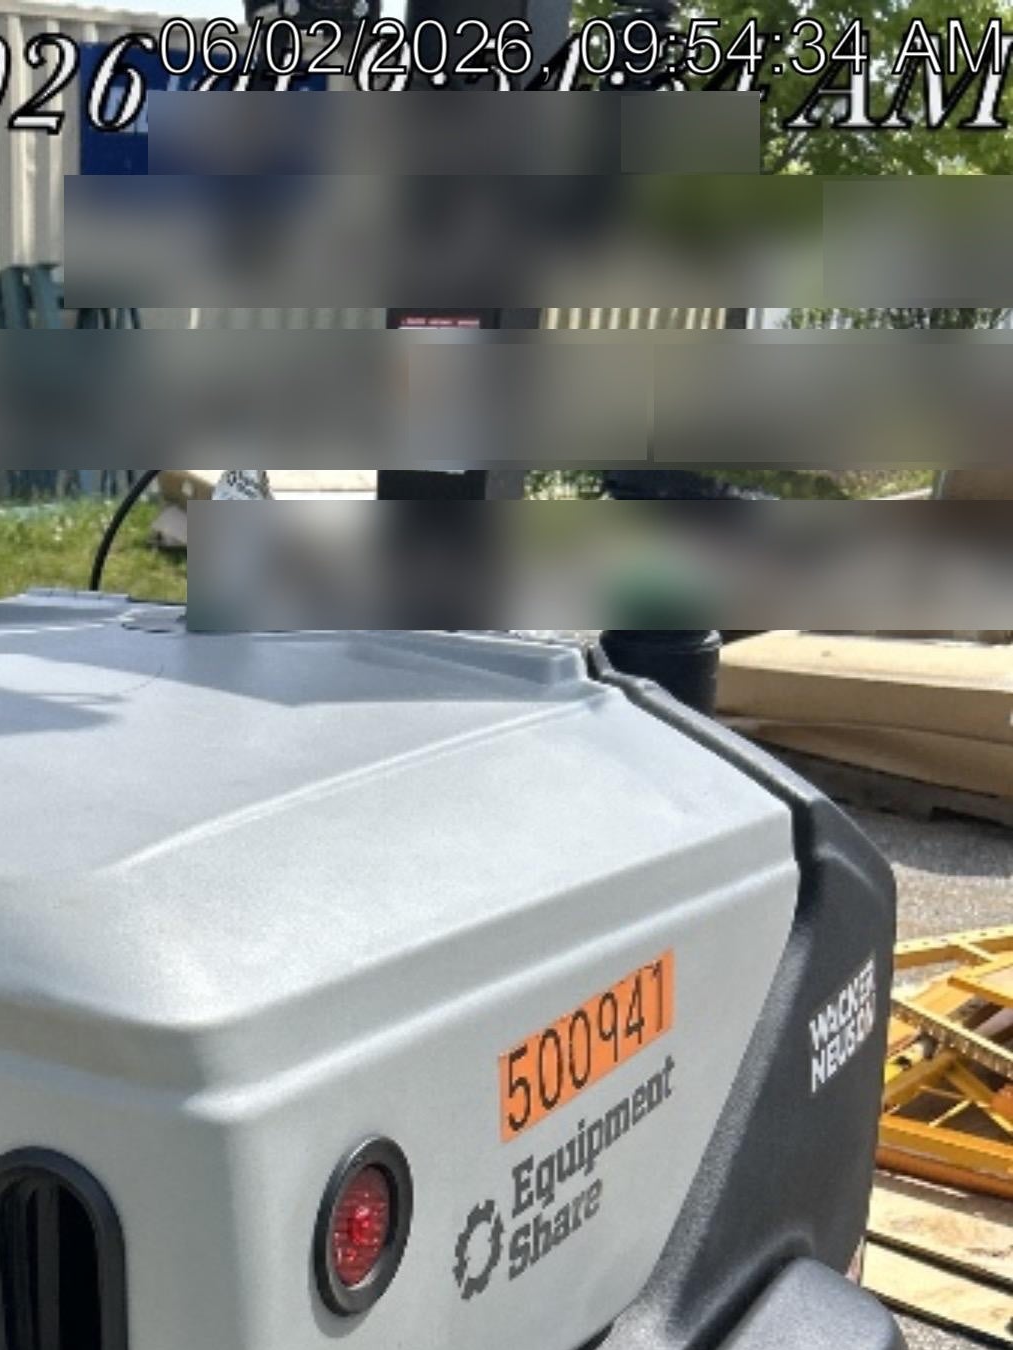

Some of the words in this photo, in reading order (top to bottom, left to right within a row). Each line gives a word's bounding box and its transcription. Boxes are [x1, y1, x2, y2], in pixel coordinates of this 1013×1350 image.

[507, 959, 665, 1132] 500941
[809, 957, 876, 1051] WACKER
[811, 992, 876, 1093] NEUSON
[511, 1055, 676, 1218] Equipment
[507, 1178, 603, 1282] Share
